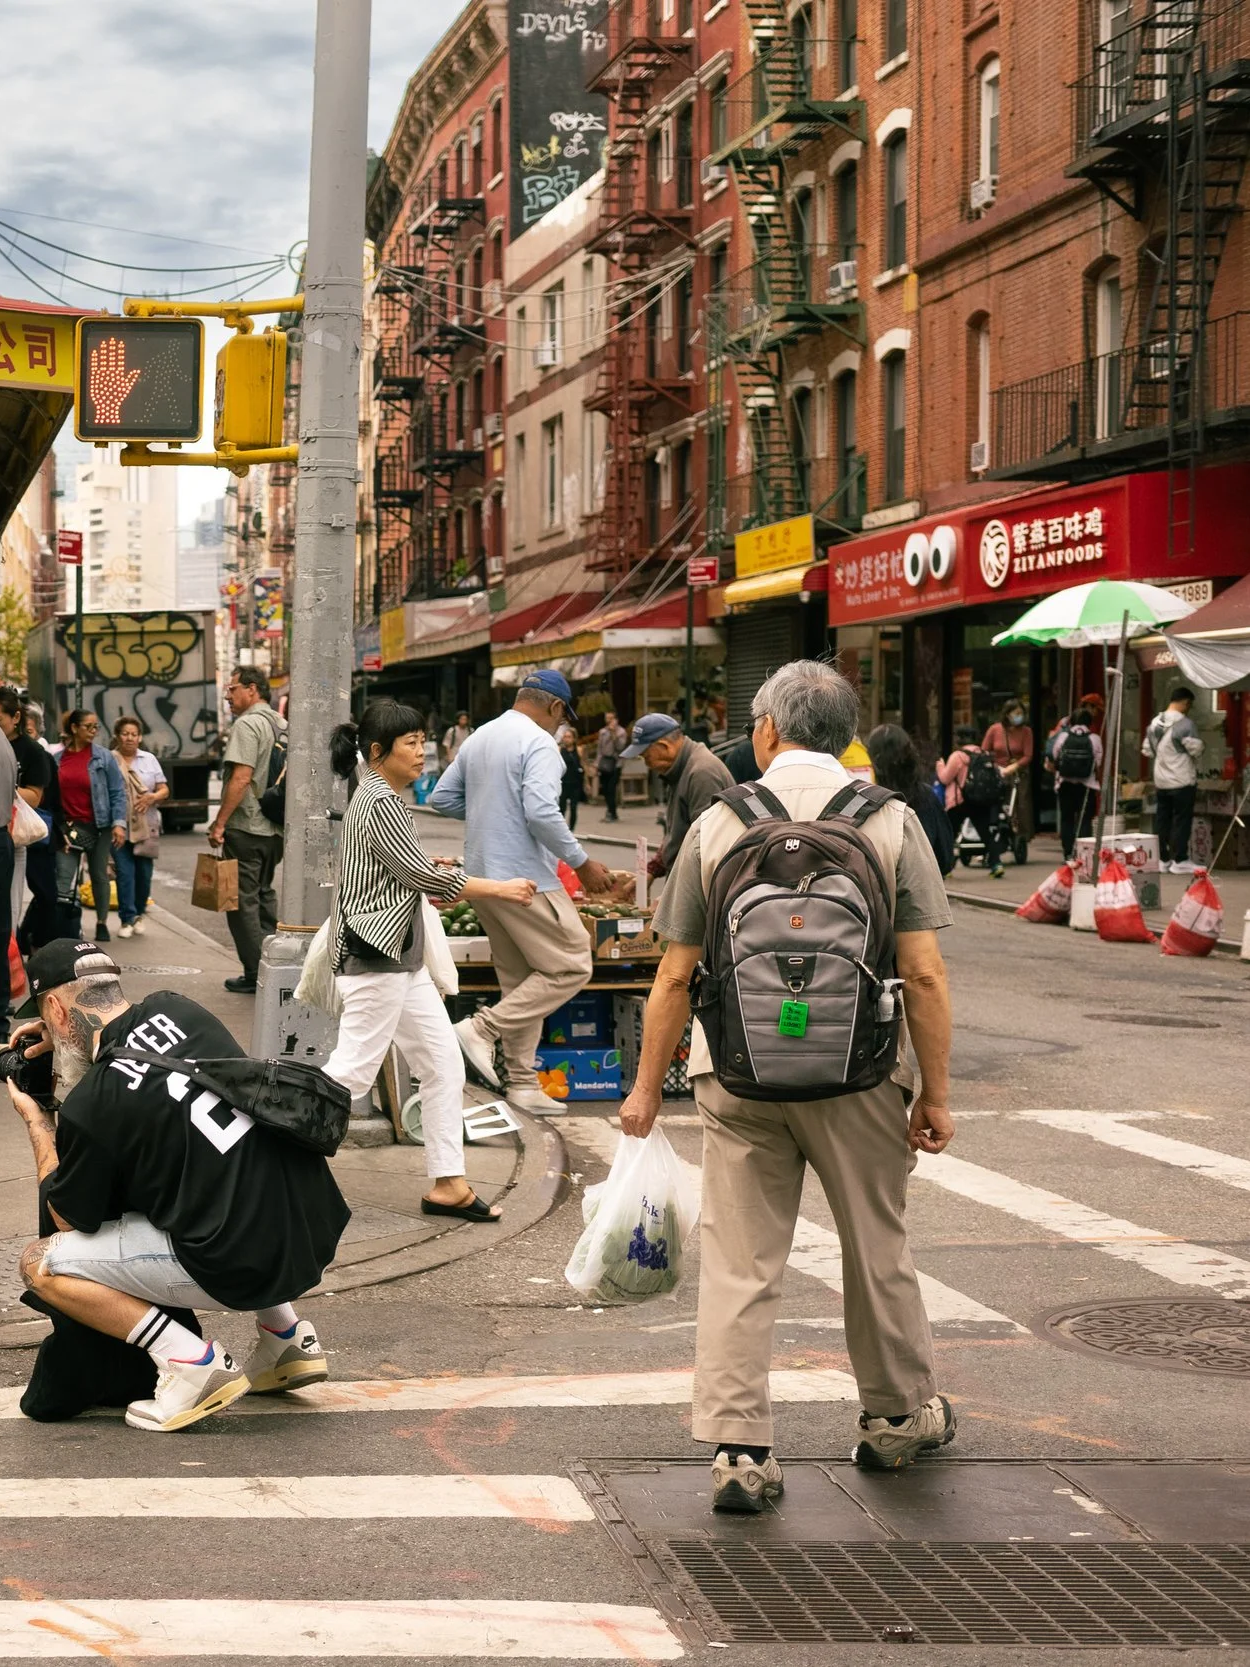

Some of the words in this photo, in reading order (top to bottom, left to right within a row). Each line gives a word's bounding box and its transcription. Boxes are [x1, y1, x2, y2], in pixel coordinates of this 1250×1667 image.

[1012, 507, 1103, 554] 紫燕百味鸡
[1013, 542, 1103, 573] ZIYANFOODS
[574, 1081, 618, 1091] Mandarins
